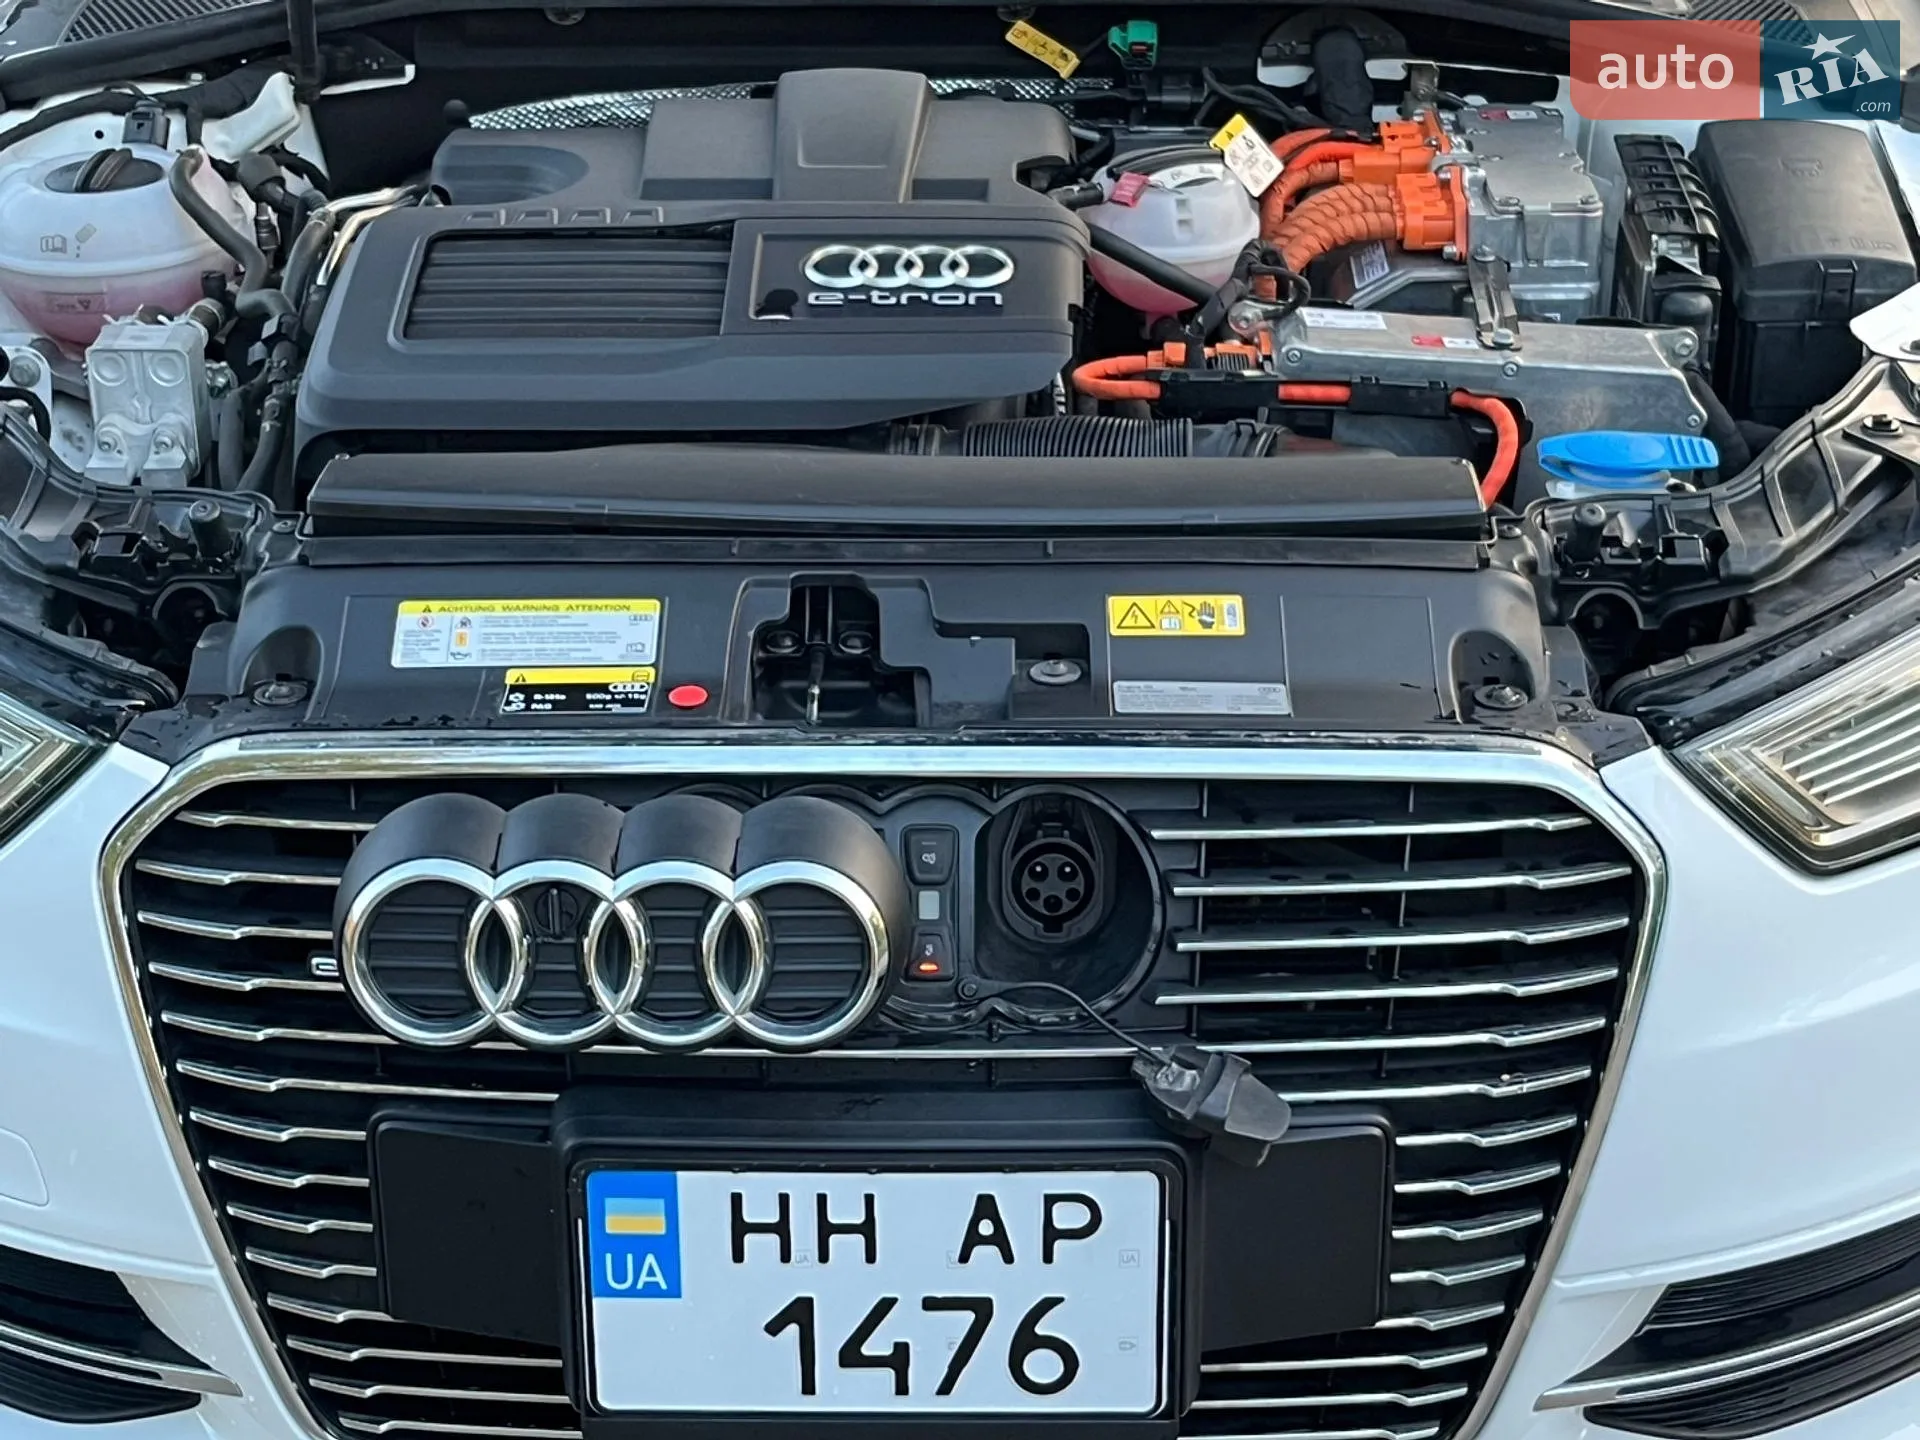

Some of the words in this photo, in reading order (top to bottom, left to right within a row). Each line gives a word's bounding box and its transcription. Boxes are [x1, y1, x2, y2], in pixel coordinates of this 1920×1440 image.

[807, 290, 1003, 306] e-tron
[501, 604, 560, 612] WARNING
[565, 603, 631, 611] ATTENTION
[730, 1191, 878, 1265] HH
[957, 1192, 1103, 1265] AP
[604, 1252, 668, 1290] UA
[764, 1296, 1081, 1397] 1476
